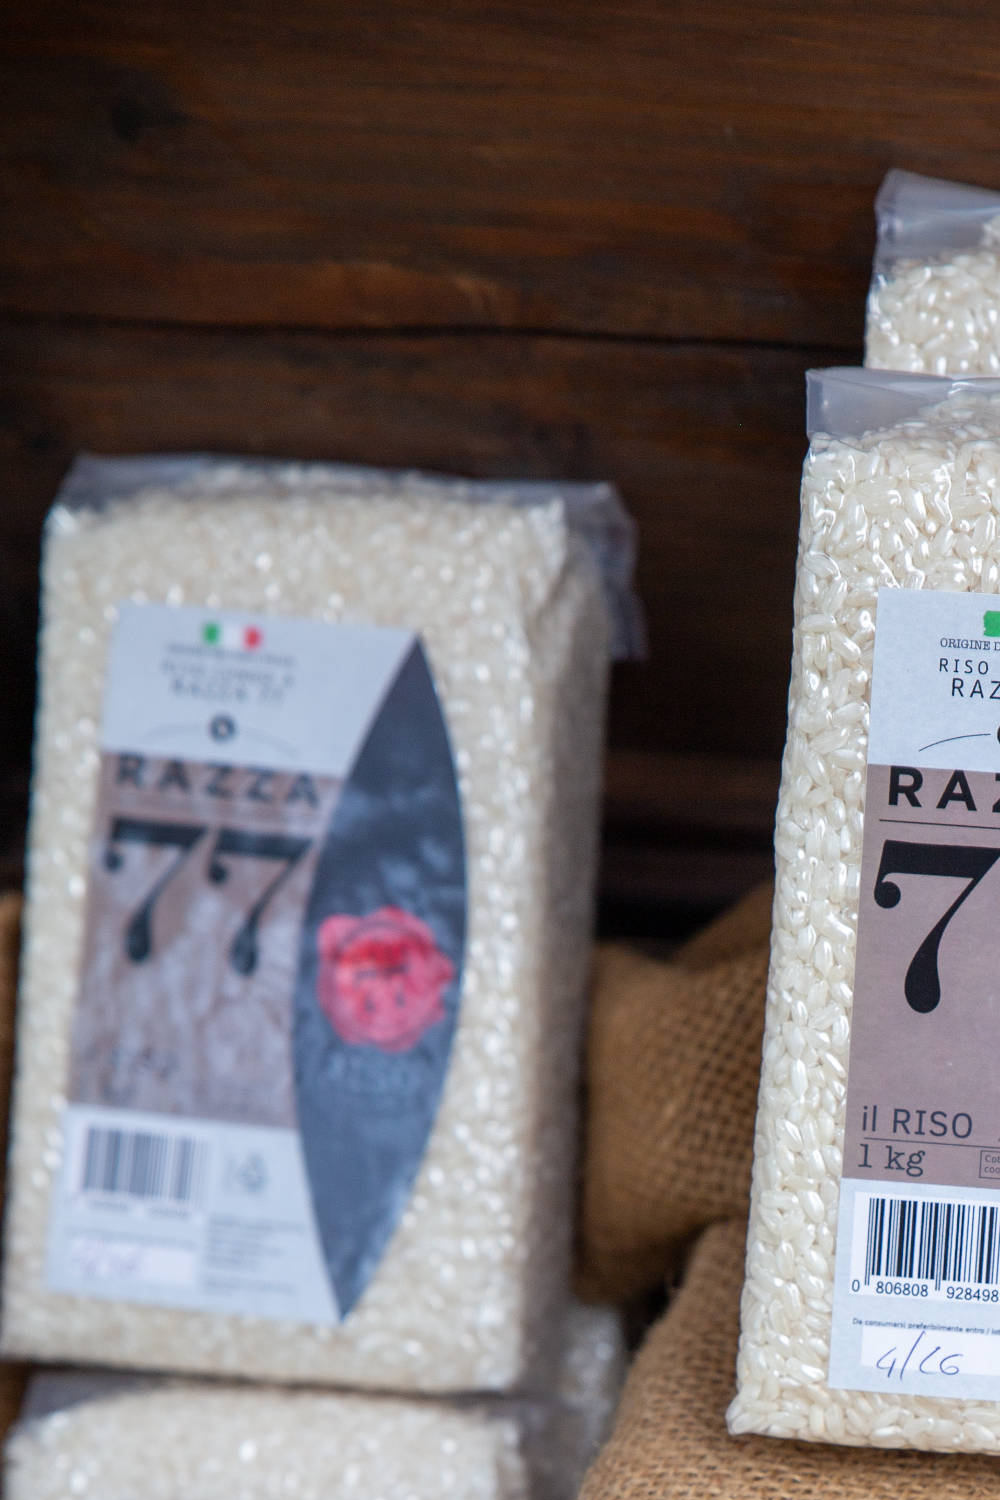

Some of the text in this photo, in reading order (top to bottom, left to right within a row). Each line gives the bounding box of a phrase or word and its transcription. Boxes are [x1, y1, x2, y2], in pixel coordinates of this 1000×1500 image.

[940, 638, 991, 650] ORIGINE
[939, 658, 989, 675] RISO
[117, 752, 319, 806] RAZZA
[104, 816, 317, 975] 77
[862, 1105, 973, 1139] il RISO
[858, 1144, 926, 1178] 1 kg
[851, 1279, 1000, 1304] 0 806808 928498
